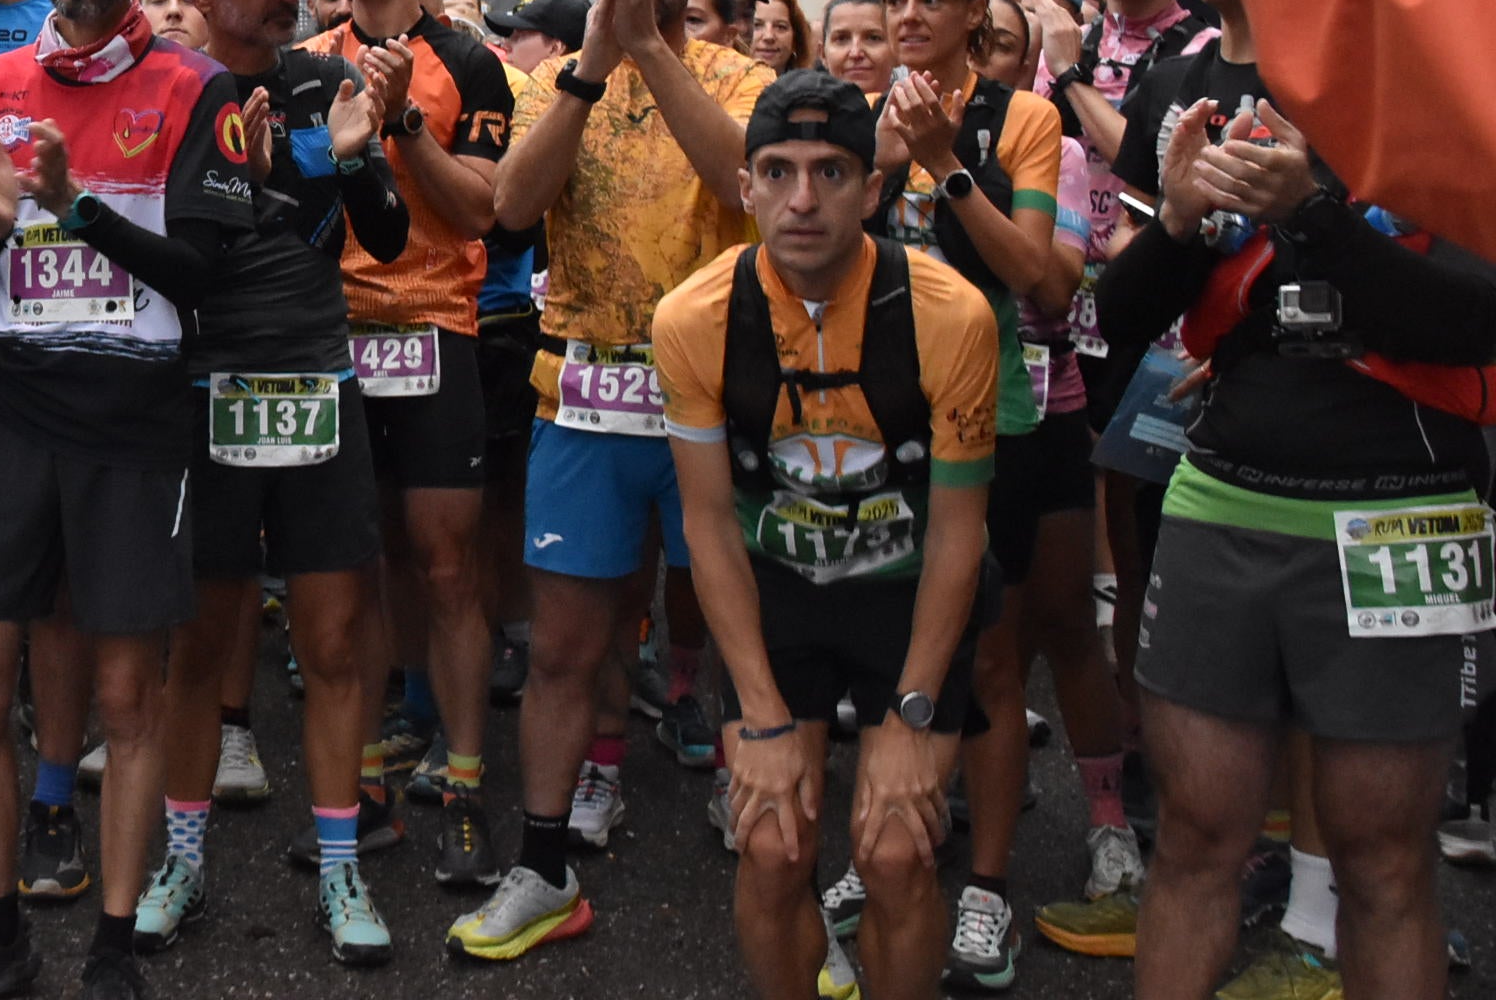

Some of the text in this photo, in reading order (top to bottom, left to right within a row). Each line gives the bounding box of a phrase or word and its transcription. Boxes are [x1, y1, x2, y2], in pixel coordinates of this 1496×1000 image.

[20, 248, 113, 289] 1344
[51, 288, 75, 298] JAIME
[228, 400, 321, 436] 1137
[1407, 514, 1460, 535] VETONA
[1368, 539, 1483, 595] 1131
